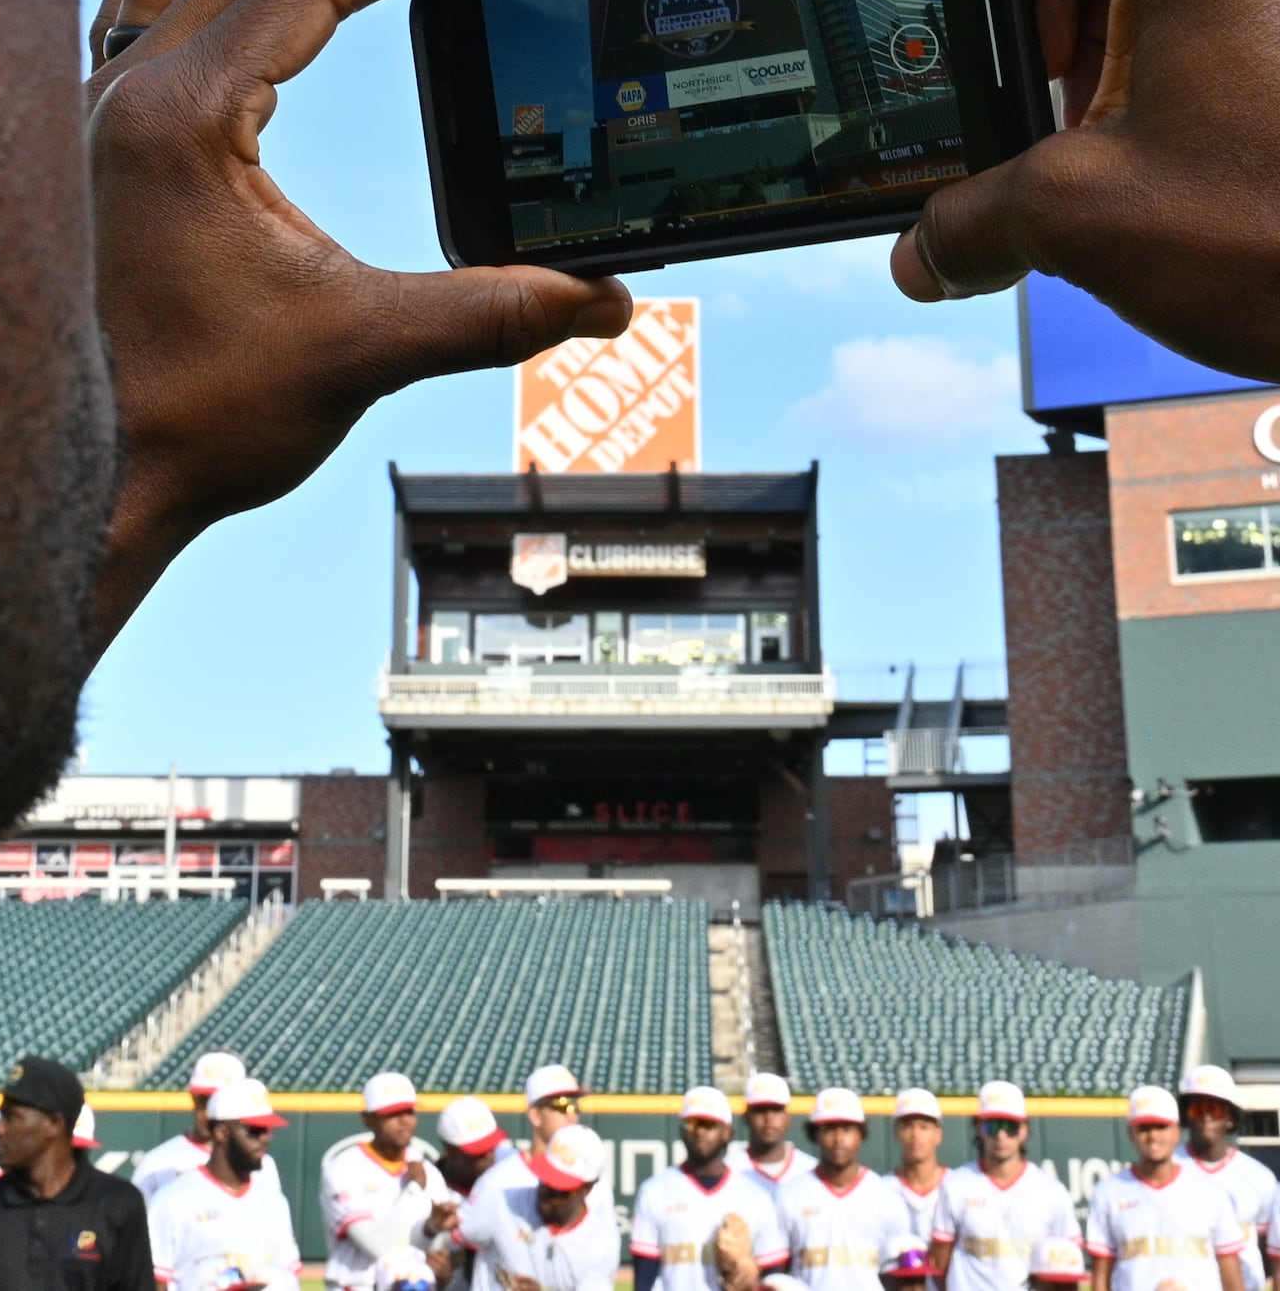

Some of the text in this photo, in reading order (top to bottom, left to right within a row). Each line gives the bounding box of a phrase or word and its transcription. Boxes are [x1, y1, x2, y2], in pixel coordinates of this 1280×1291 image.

[748, 60, 806, 79] COOLRAY
[672, 73, 733, 91] NORTHSIDE
[684, 86, 723, 95] HOSPITAL
[621, 89, 643, 104] NAPA
[627, 113, 657, 127] ORIS
[878, 147, 912, 161] WELCOME
[913, 144, 924, 155] TO
[521, 302, 695, 473] HOME
[588, 364, 696, 473] DEPOT
[569, 544, 700, 571] CLUBHOUSE
[594, 801, 692, 823] SLICE
